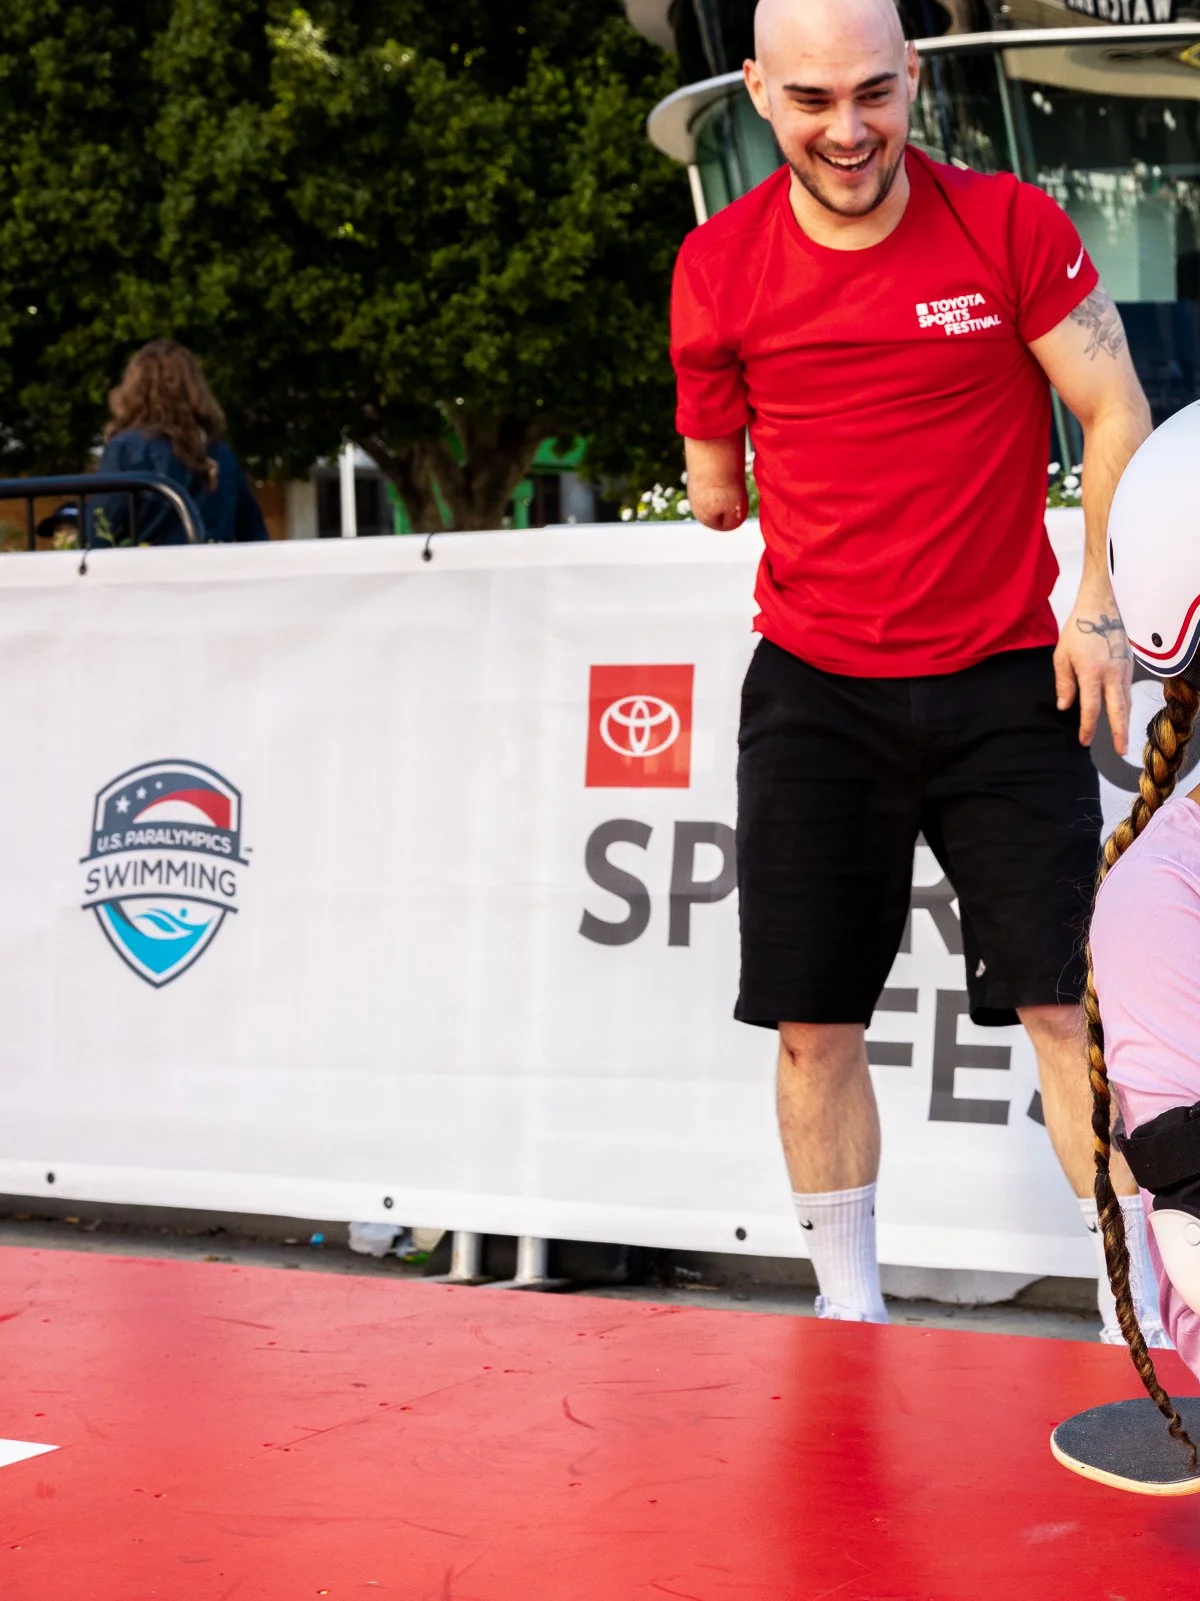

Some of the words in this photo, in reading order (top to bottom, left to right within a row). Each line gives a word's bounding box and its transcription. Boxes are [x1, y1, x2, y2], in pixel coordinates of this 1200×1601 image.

[929, 293, 986, 313] TOYOTA
[918, 308, 970, 328] SPORTS
[944, 314, 1002, 336] FESTIVAL
[96, 832, 122, 852] U.S.
[124, 828, 232, 854] PARALYMPICS
[84, 859, 237, 897] SWIMMING
